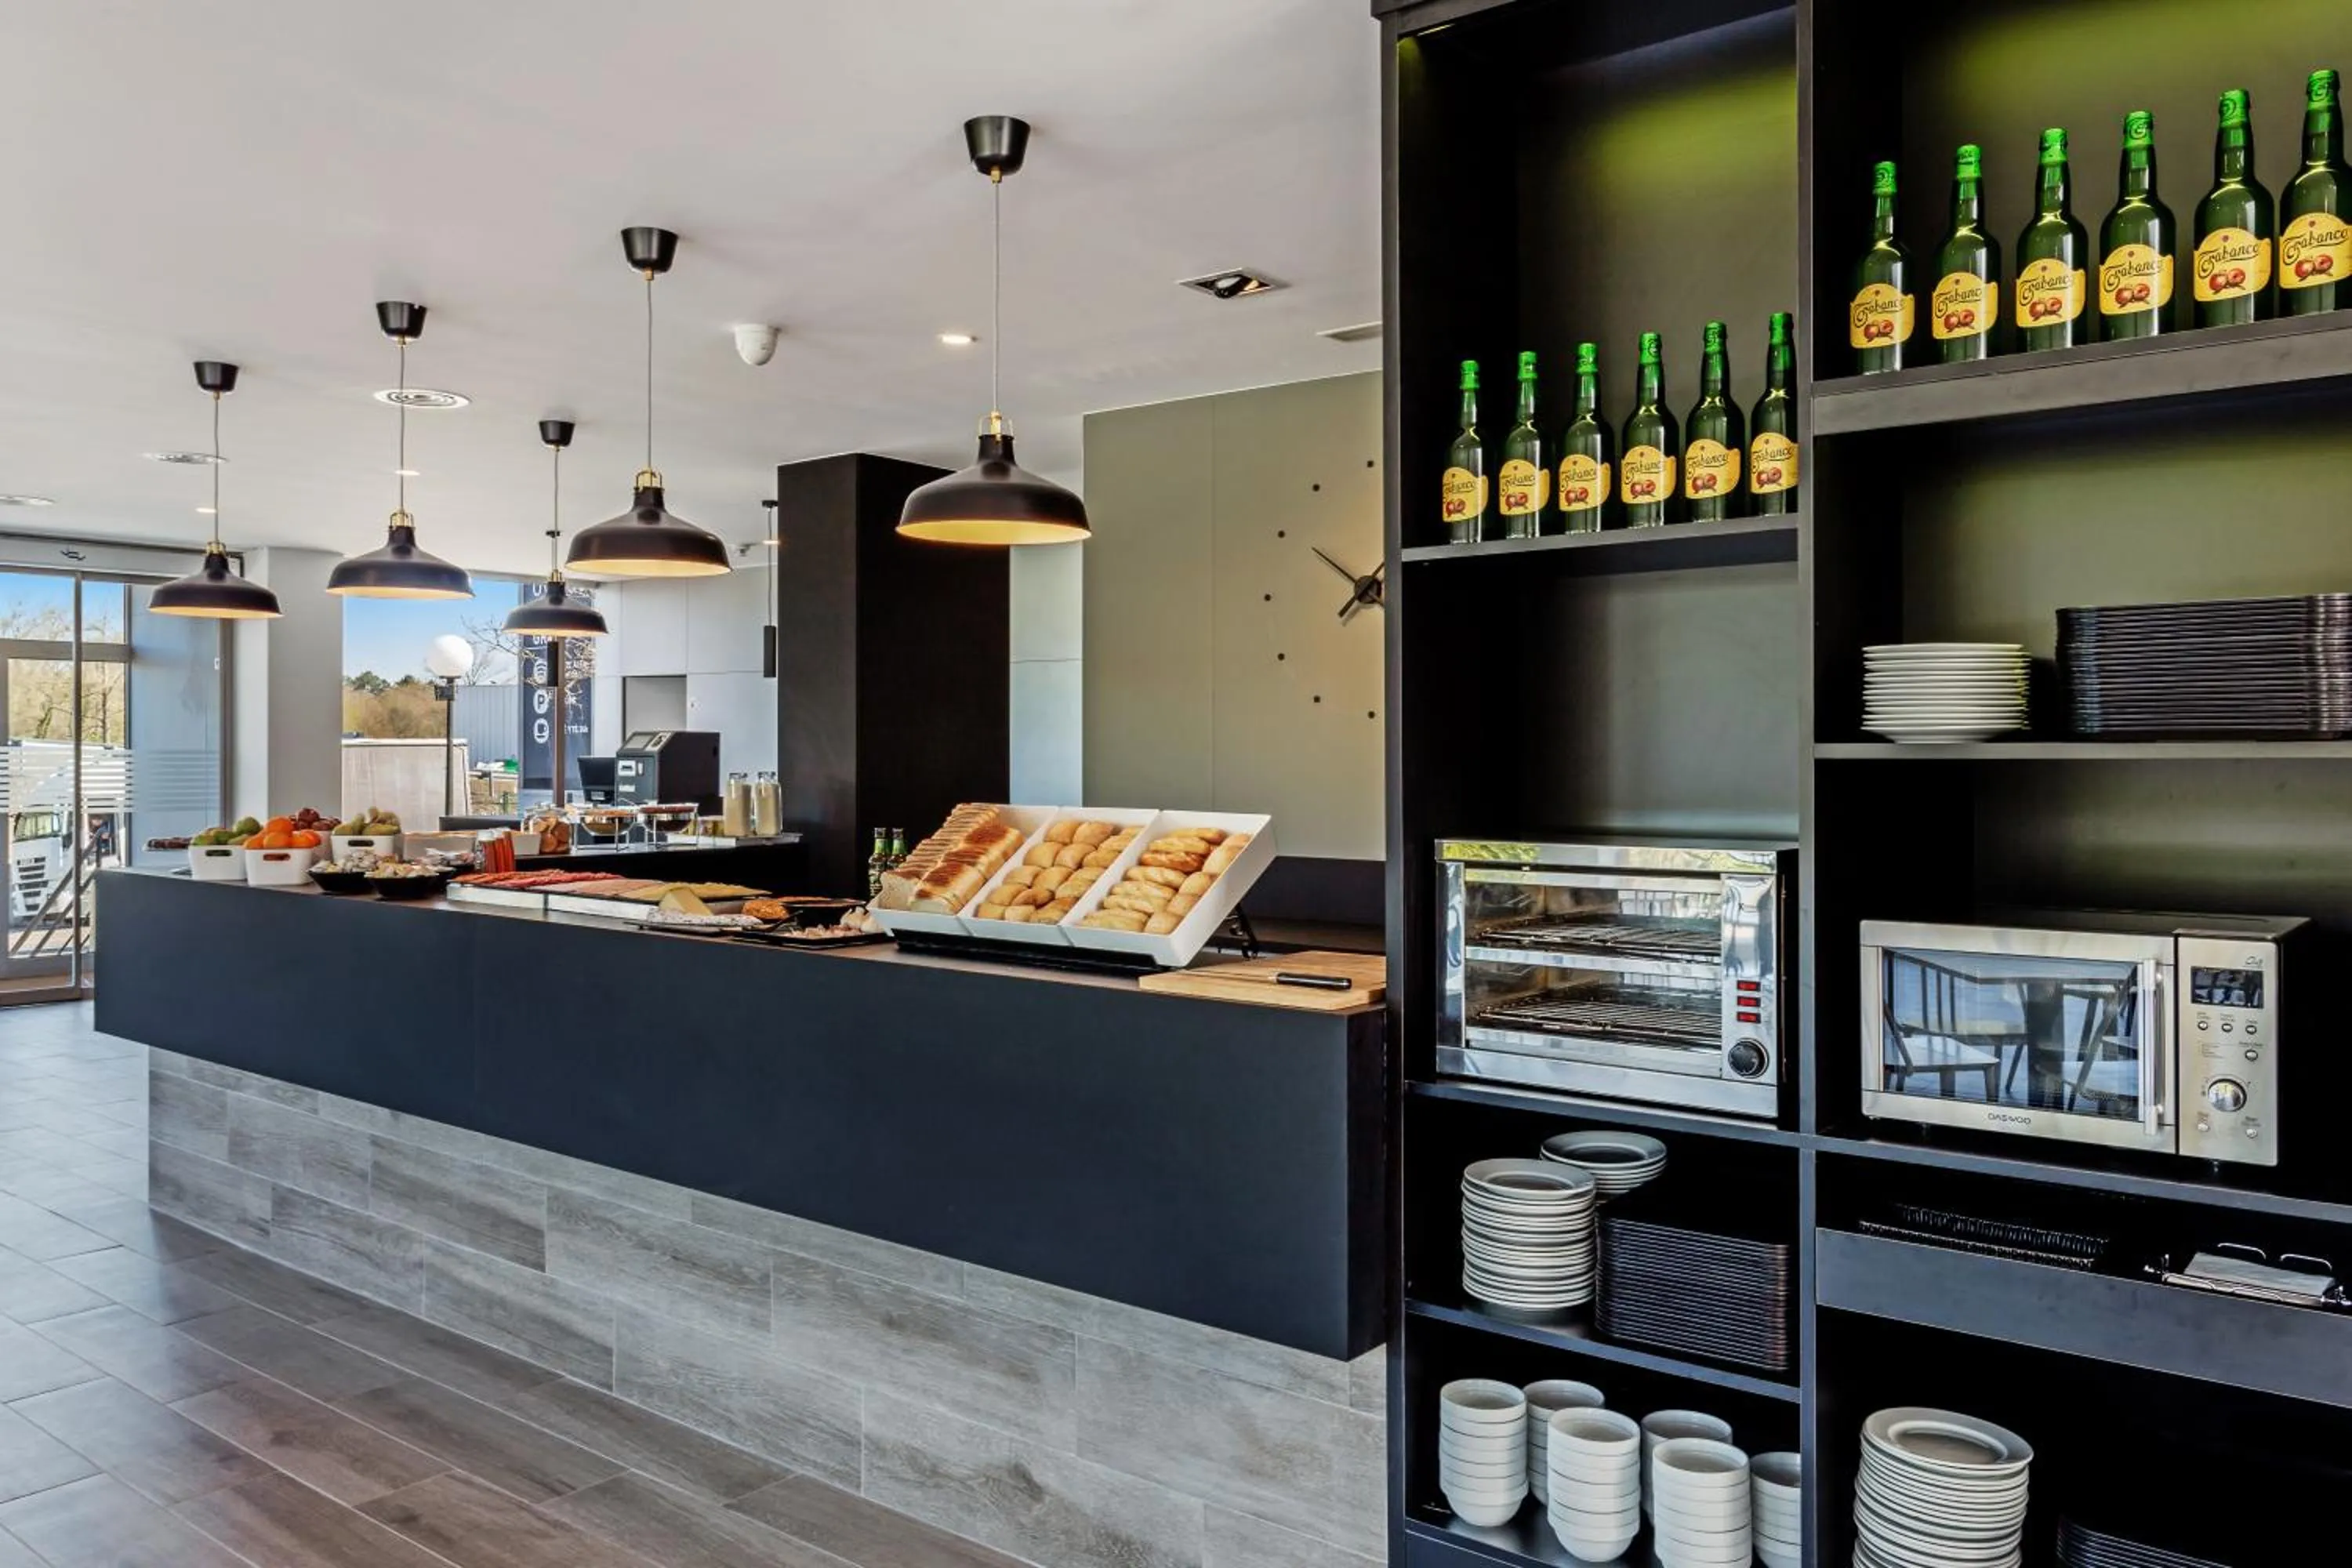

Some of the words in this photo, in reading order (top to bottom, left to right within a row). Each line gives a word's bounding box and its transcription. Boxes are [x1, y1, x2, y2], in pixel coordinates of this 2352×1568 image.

[2198, 242, 2259, 278] Trabanco
[2282, 228, 2349, 266] Trabanco
[1935, 286, 1984, 318] Trabanc
